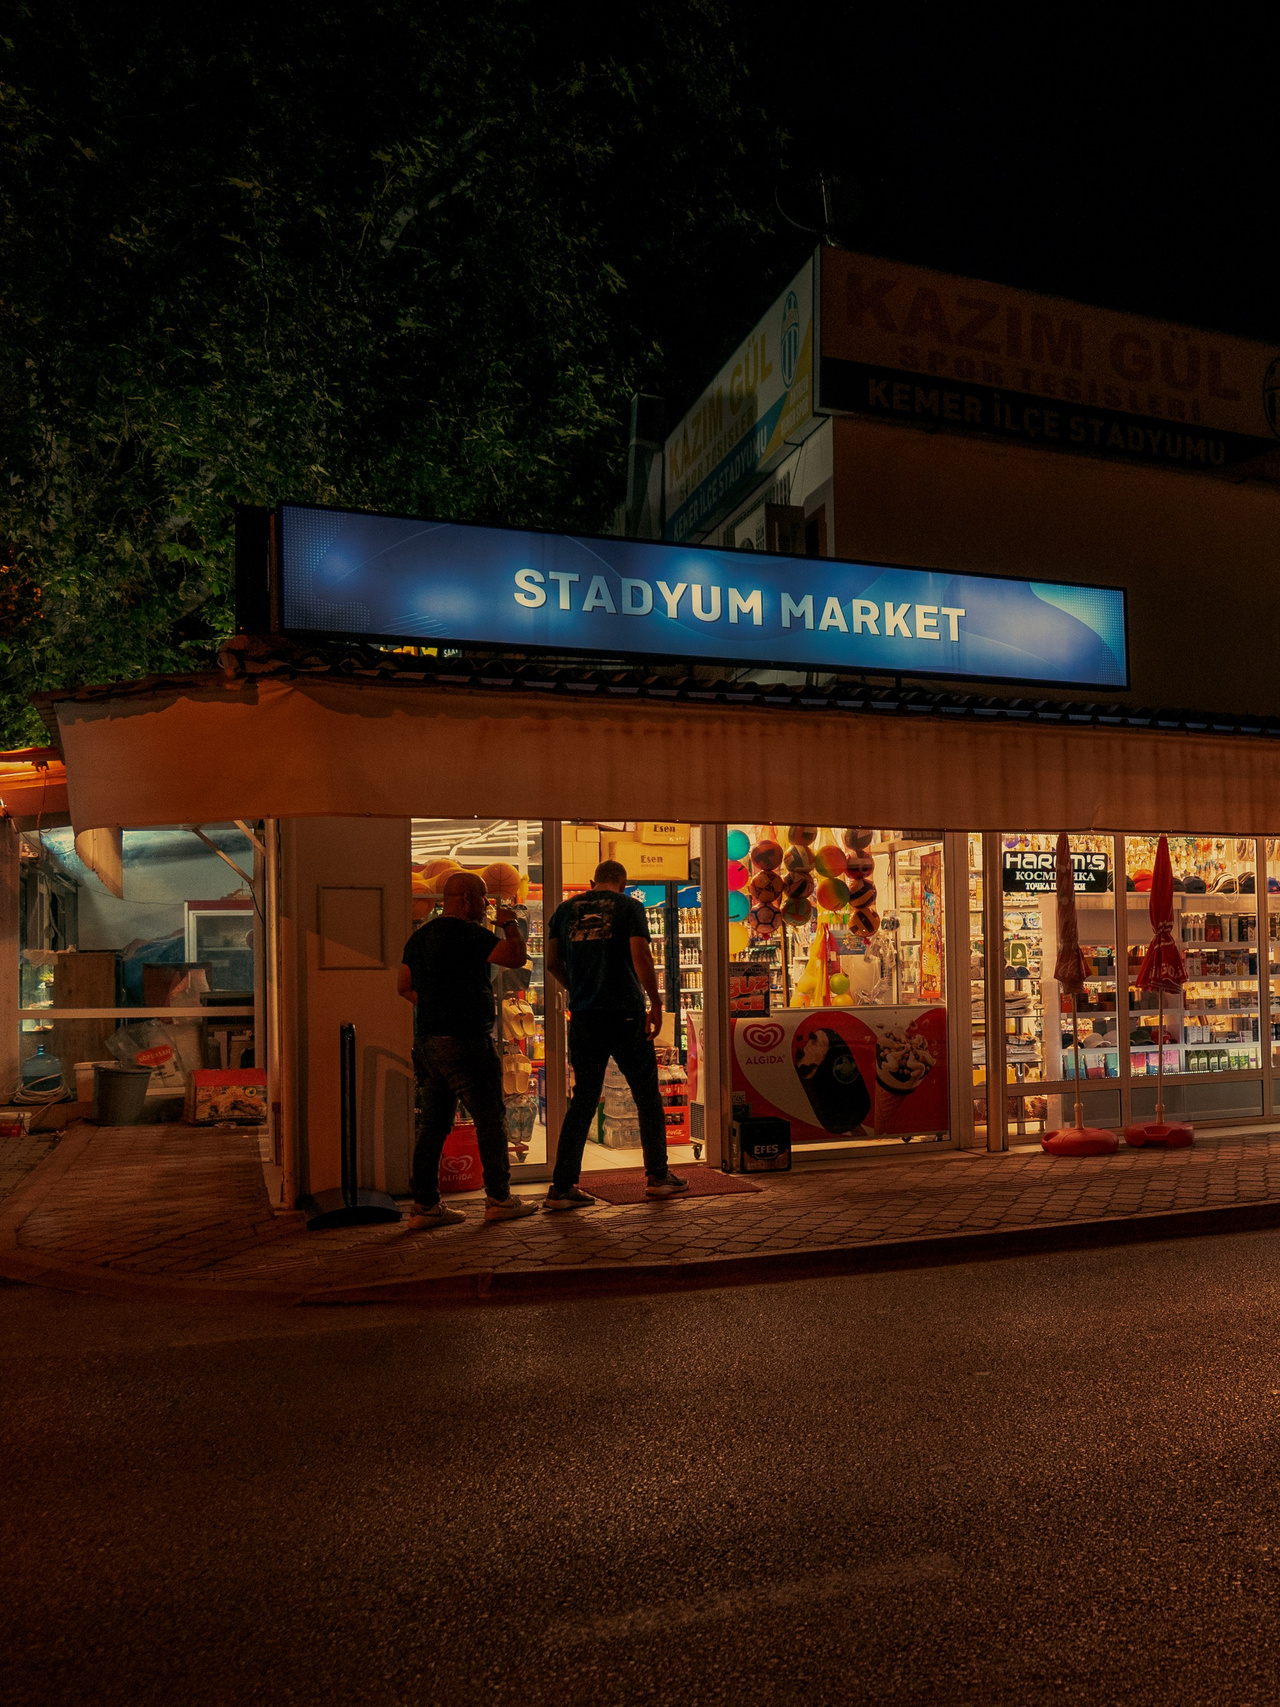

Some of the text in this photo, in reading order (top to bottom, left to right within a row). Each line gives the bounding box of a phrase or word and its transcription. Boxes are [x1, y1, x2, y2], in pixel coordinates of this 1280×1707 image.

[846, 271, 1240, 402] KAZIM GÜL
[729, 333, 773, 415] GÜL
[867, 377, 983, 423] KEMER
[993, 393, 1062, 439] İLÇE
[1068, 415, 1227, 467] STADYUMU
[513, 566, 966, 642] STADYUM MARKET
[653, 824, 676, 832] Esen
[640, 854, 664, 863] Esen
[1015, 871, 1096, 881] КОСМИКА
[754, 1144, 779, 1155] EFES
